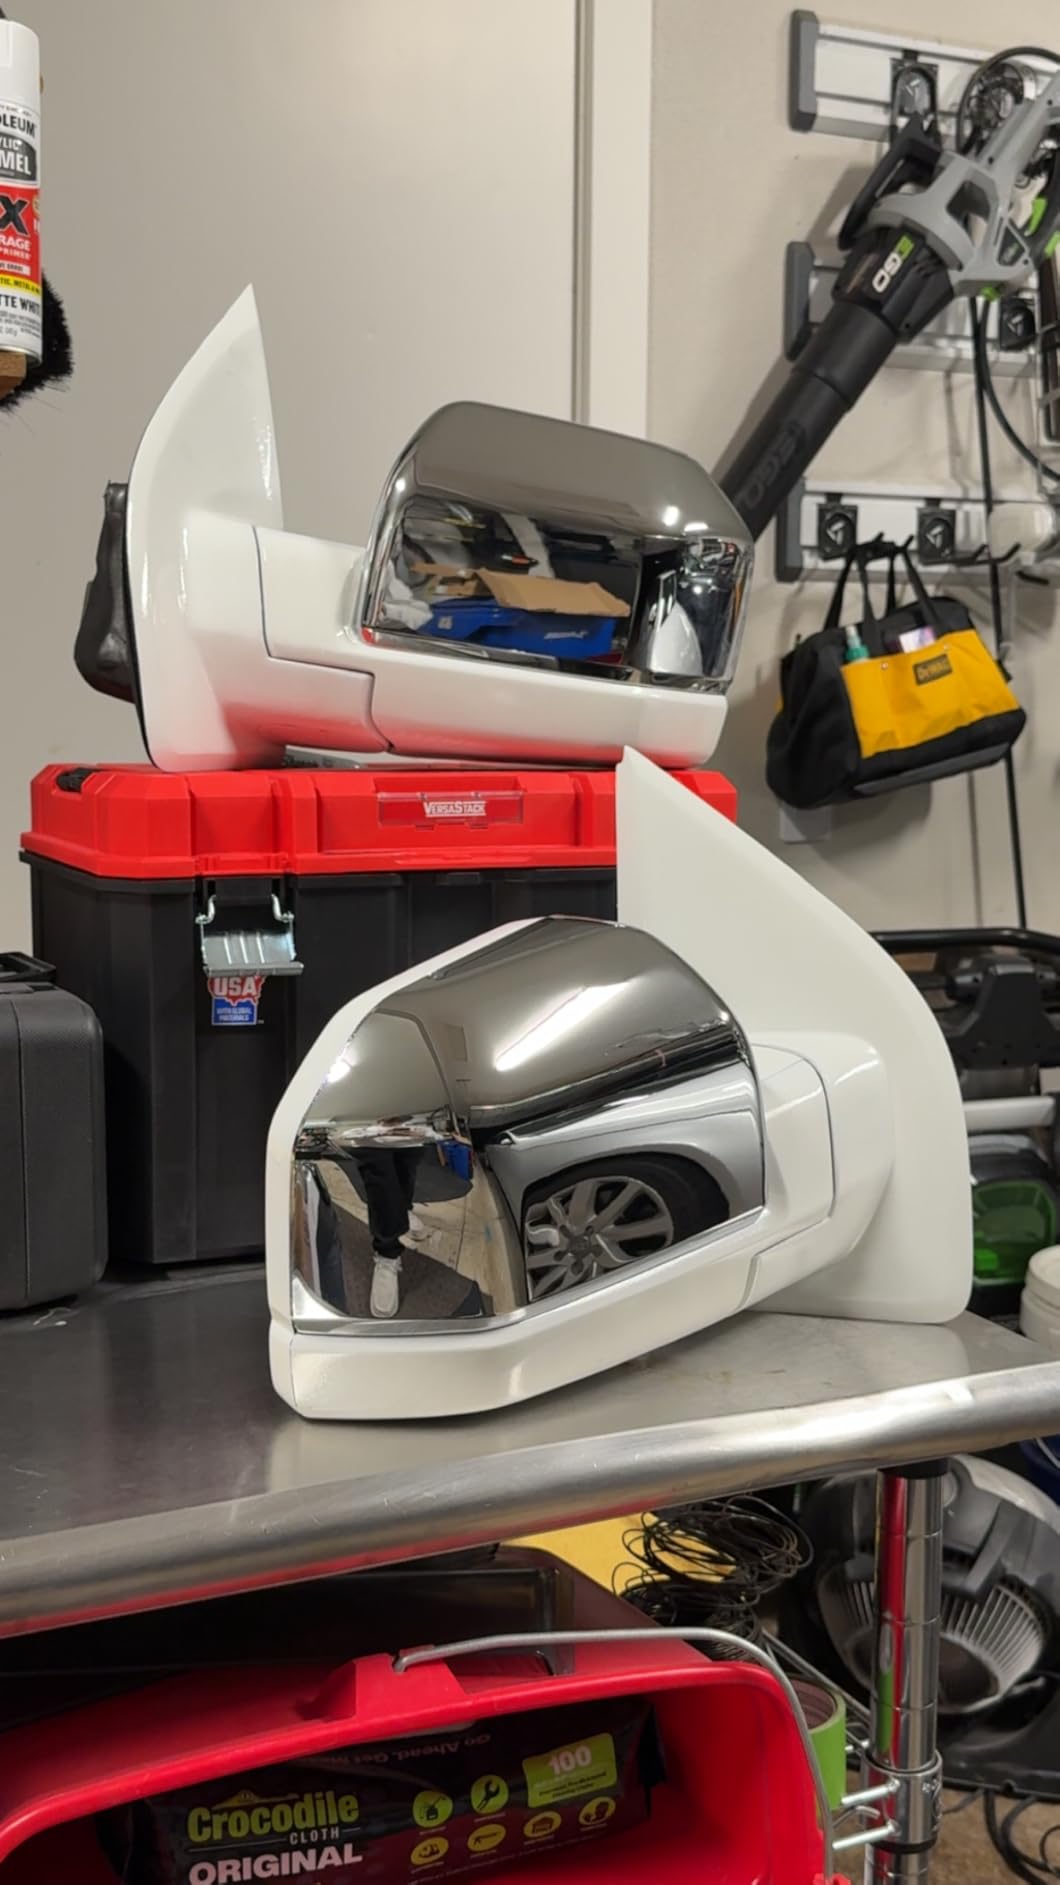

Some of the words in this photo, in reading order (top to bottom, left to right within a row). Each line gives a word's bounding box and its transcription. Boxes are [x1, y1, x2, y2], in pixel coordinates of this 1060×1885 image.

[0, 113, 36, 138] LEUM
[872, 235, 915, 293] EGO
[214, 977, 257, 996] USA
[549, 1745, 592, 1776] 100
[188, 1790, 361, 1843] Crocodile
[289, 1826, 340, 1846] CLOTH
[188, 1843, 363, 1885] ORIGINAL
